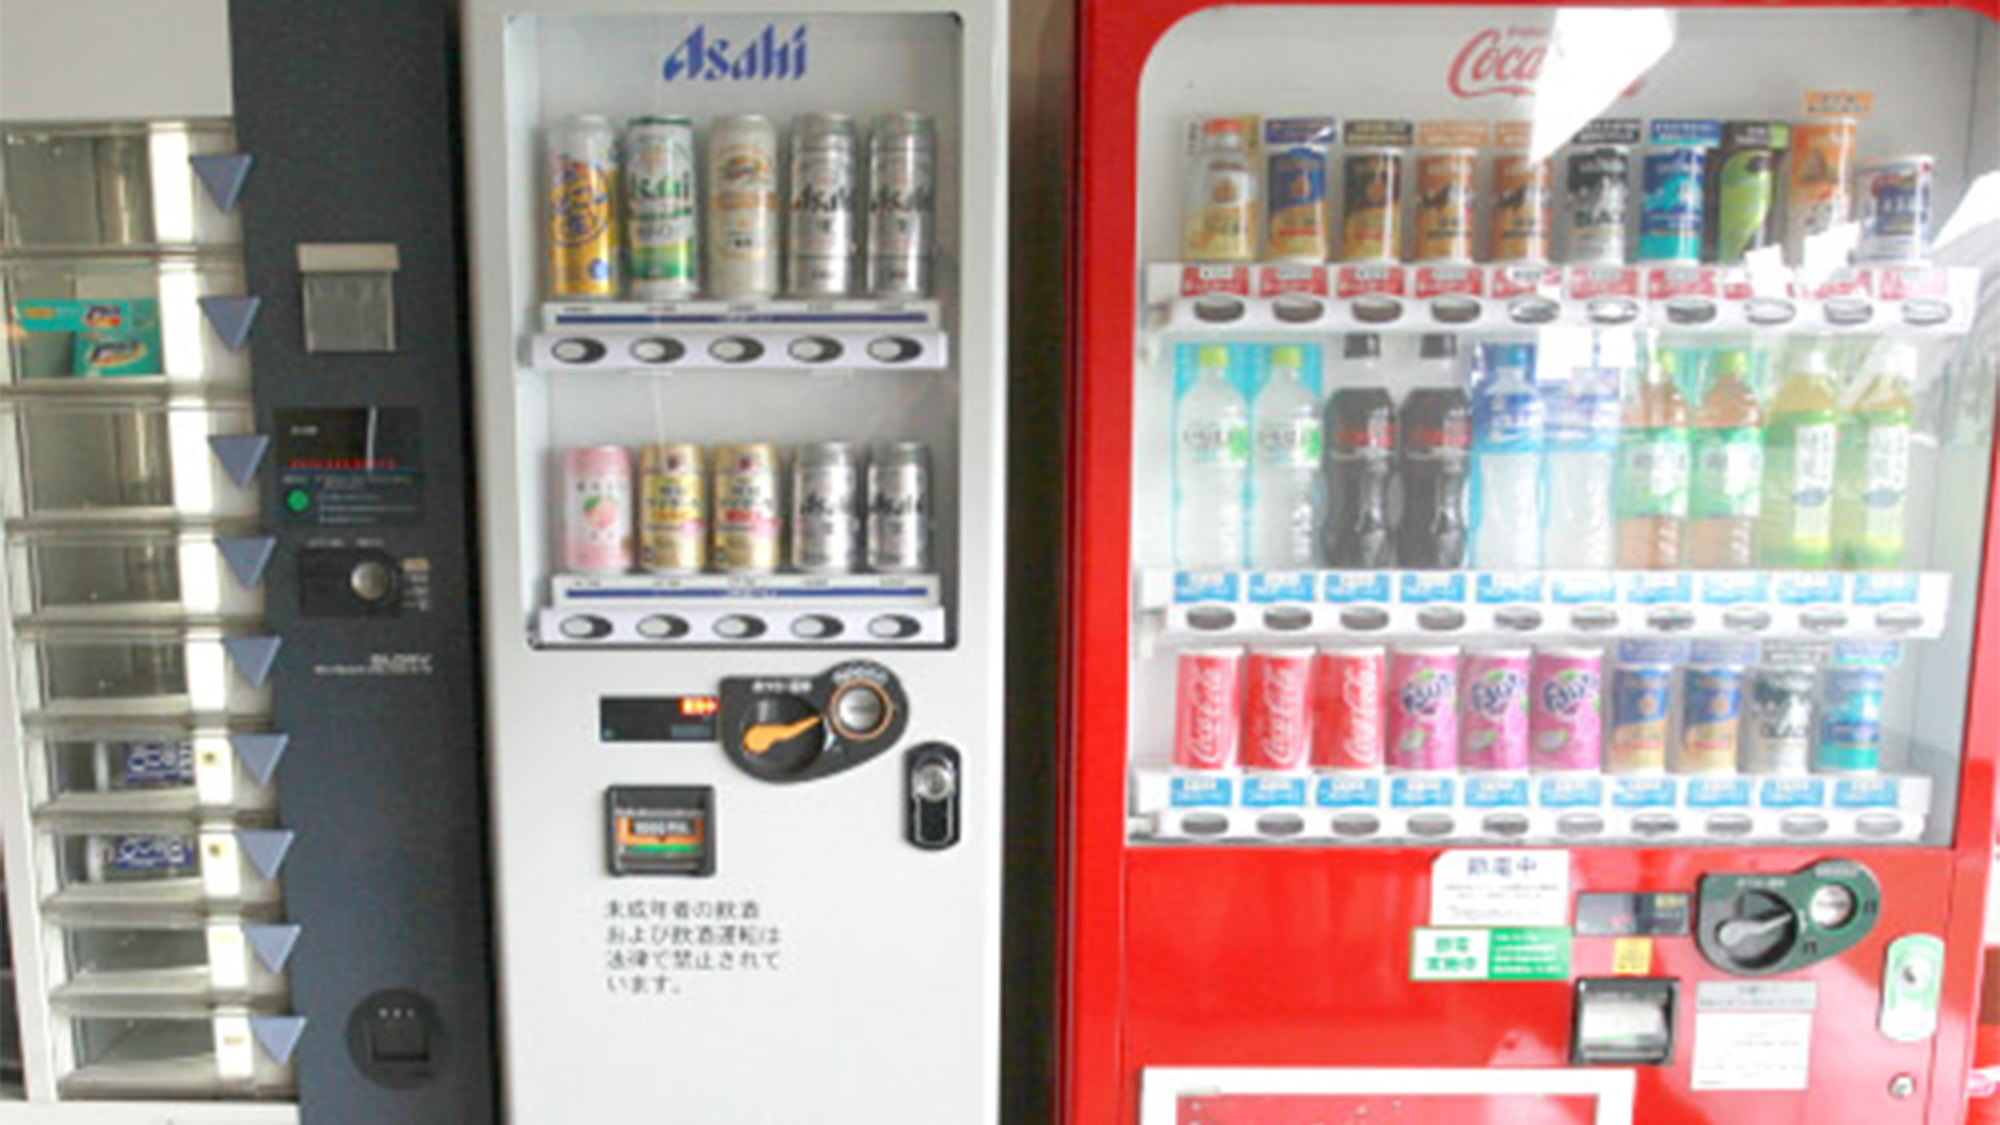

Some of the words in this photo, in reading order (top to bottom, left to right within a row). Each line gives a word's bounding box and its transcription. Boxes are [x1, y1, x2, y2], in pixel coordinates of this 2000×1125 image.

[662, 23, 808, 82] Asahi
[604, 899, 761, 920] 未成年者の飲酒
[605, 925, 781, 946] および飲酒運転は
[605, 950, 781, 972] 法律で禁止されて
[606, 975, 683, 995] います。
